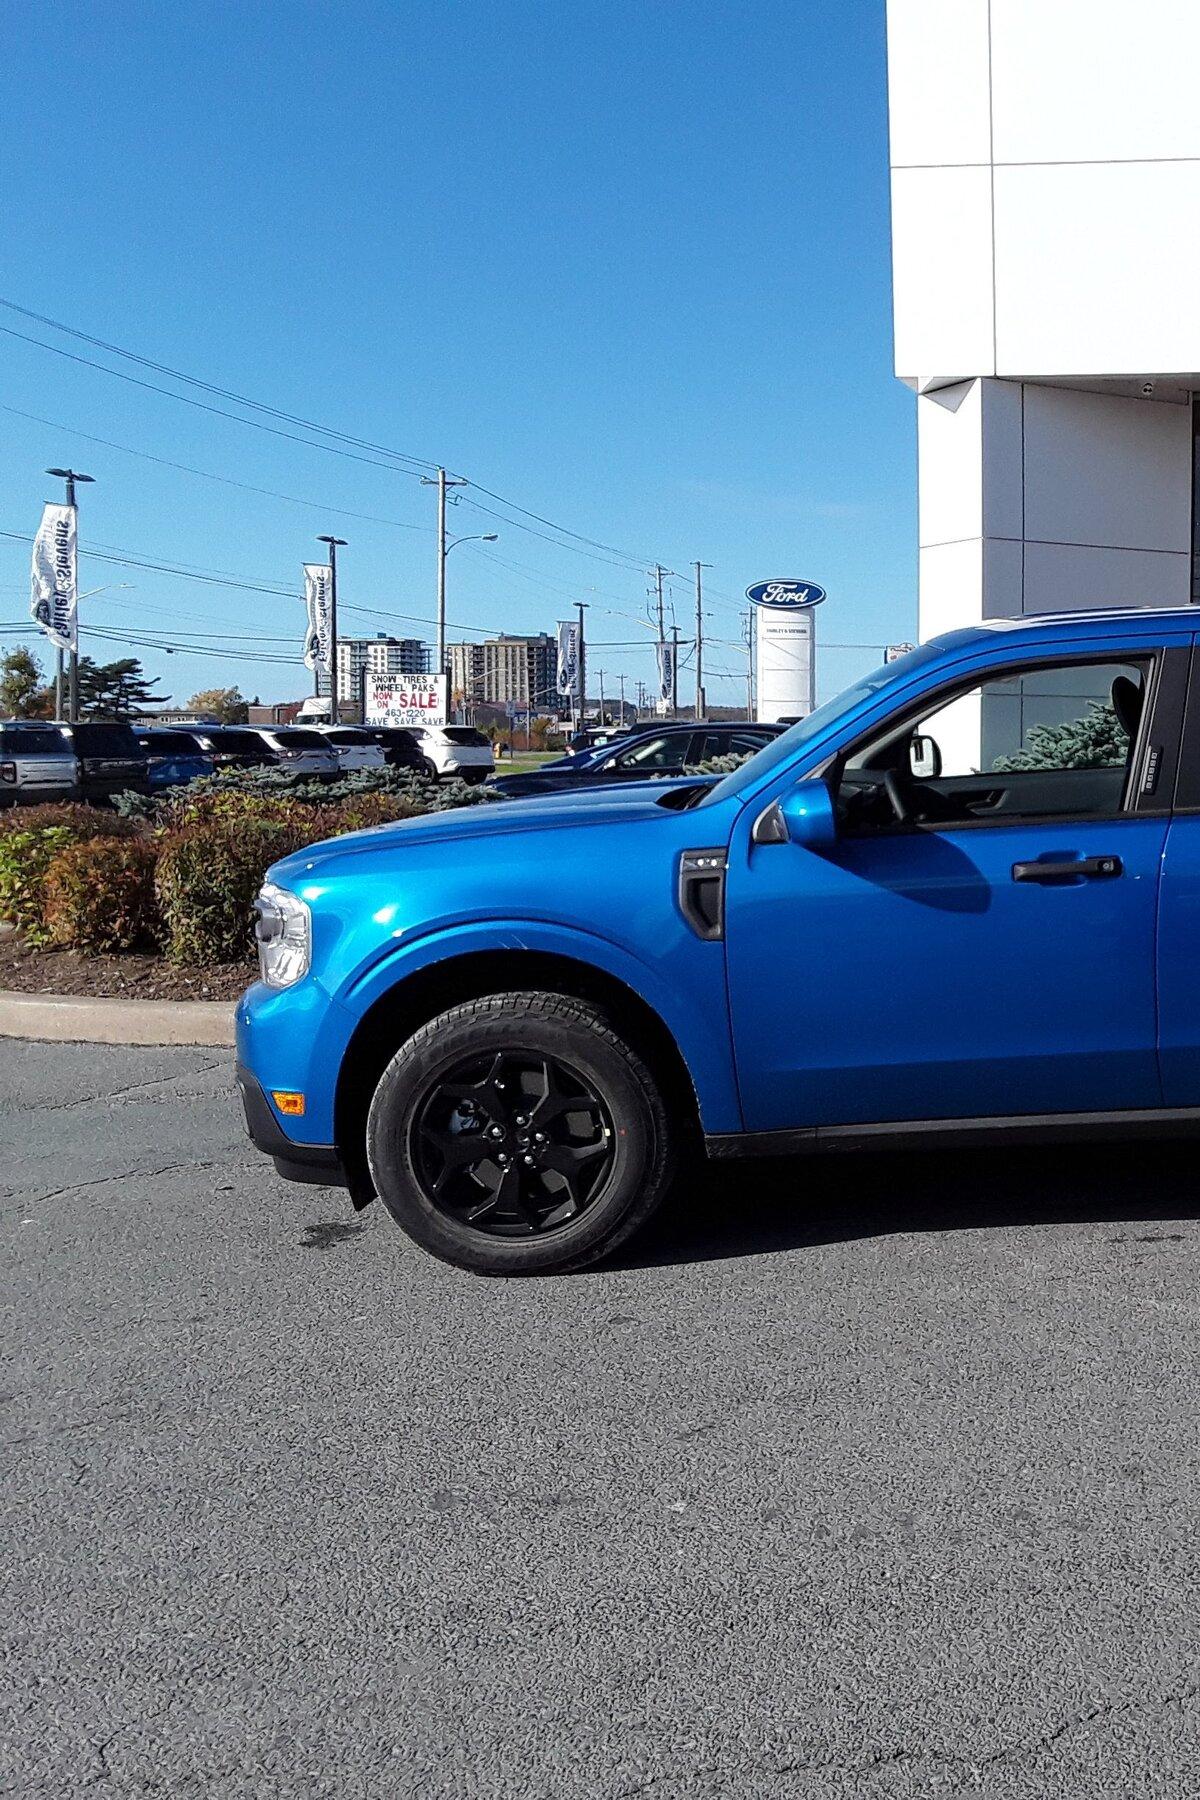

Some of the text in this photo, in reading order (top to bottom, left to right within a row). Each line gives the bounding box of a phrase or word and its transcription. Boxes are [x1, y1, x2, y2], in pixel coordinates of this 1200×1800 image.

[762, 583, 810, 602] Ford
[371, 675, 439, 684] SNOW TIRES &
[375, 684, 435, 692] WHEEL PAKS
[373, 692, 438, 708] NOW SALE
[385, 709, 426, 717] 463-1220
